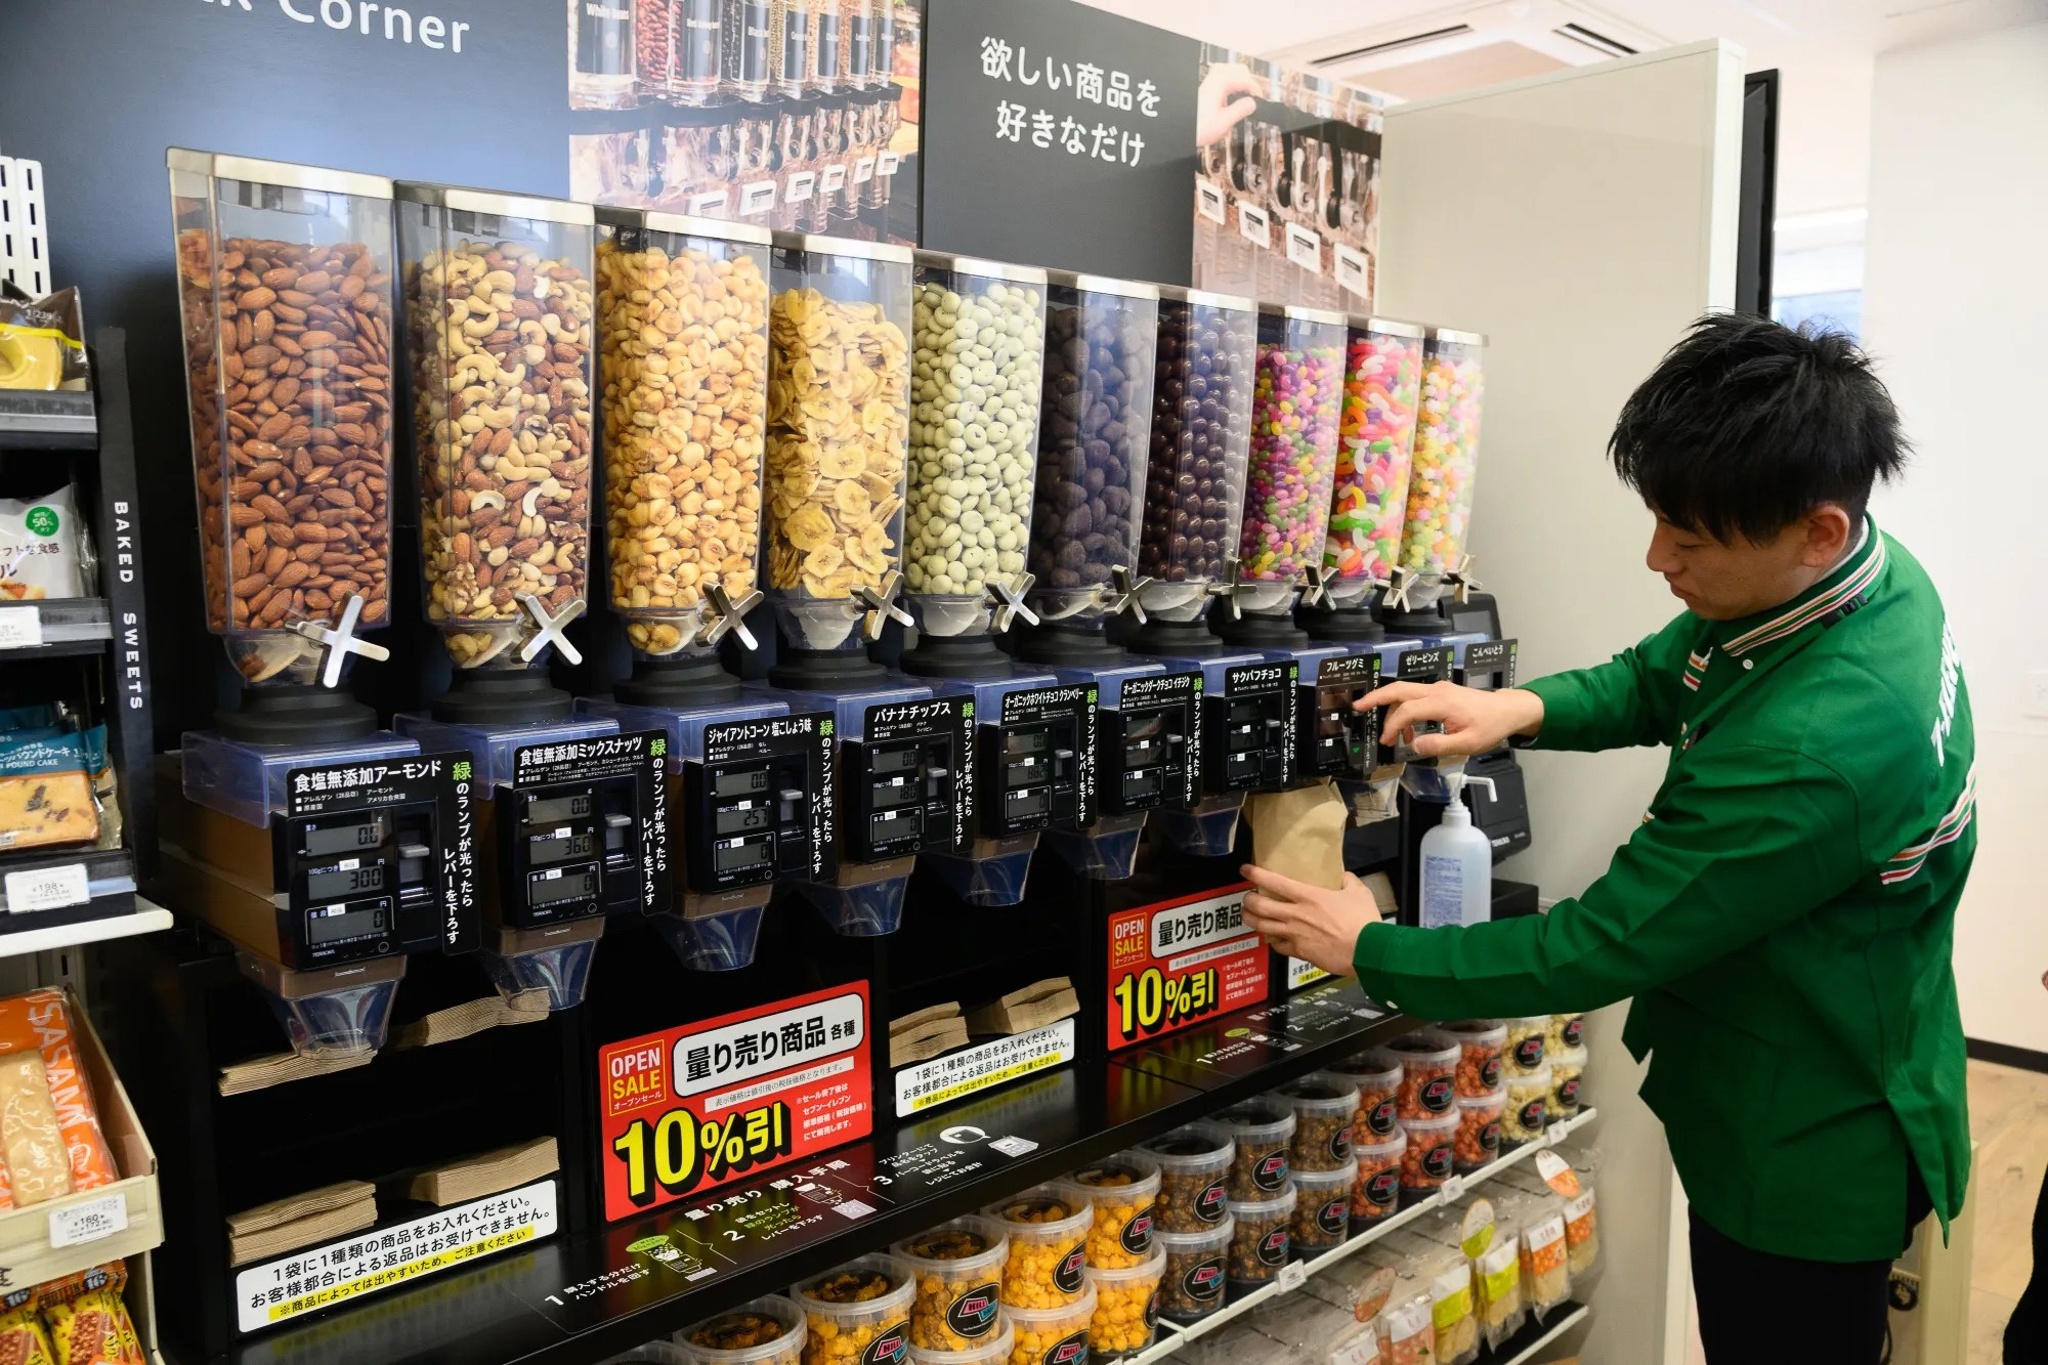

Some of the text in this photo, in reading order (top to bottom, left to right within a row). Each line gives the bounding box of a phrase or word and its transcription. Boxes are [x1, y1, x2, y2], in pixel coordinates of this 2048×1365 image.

[279, 0, 470, 53] Corner
[980, 36, 1161, 118] 欲しい商品を
[996, 99, 1146, 167] 好きなだけ
[113, 501, 143, 709] BAKED SWEETS
[1326, 657, 1364, 673] フルーツグミ
[708, 718, 812, 744] ジャイアントコーン 塩こしょう味
[874, 702, 951, 723] バナナチップス
[294, 760, 442, 794] 食塩無添加アーモンド
[520, 736, 642, 767] 食塩無添加ミックスナッツ
[819, 720, 834, 843] 緑のランプが光ったら
[962, 702, 975, 817] 緑のランプが光ったら
[452, 761, 474, 907] 緑のランプが光ったら
[650, 738, 667, 872] 緑のランプが光ったら
[811, 792, 822, 874] レバーを下ろす
[955, 770, 964, 846] レバーを下ろす
[350, 868, 381, 890] 300
[642, 817, 655, 906] レバーを下ろす
[443, 848, 460, 944] レバーを下ろす
[1114, 918, 1145, 940] OPEN
[1158, 903, 1243, 947] 量り売り商品
[1114, 938, 1144, 957] SALE
[1114, 967, 1215, 1034] 10%引
[611, 1047, 661, 1078] OPEN
[686, 1016, 856, 1082] 量り売り商品 各種
[903, 1041, 1070, 1100] お客様都合による返品はお受けできません。
[915, 1030, 1060, 1081] 1袋に1種類の商品をお入れください。
[613, 1069, 662, 1100] SALE
[613, 1091, 663, 1110] オープンセール
[614, 1102, 783, 1198] 10%引
[251, 1207, 550, 1309] お客様都合による返品はお受けできません。
[273, 1196, 531, 1282] 1袋に1種類の商品をお入れください。
[723, 1230, 746, 1241] 2
[278, 1230, 526, 1316] ※商品によっては出やすいため、ご注意ください
